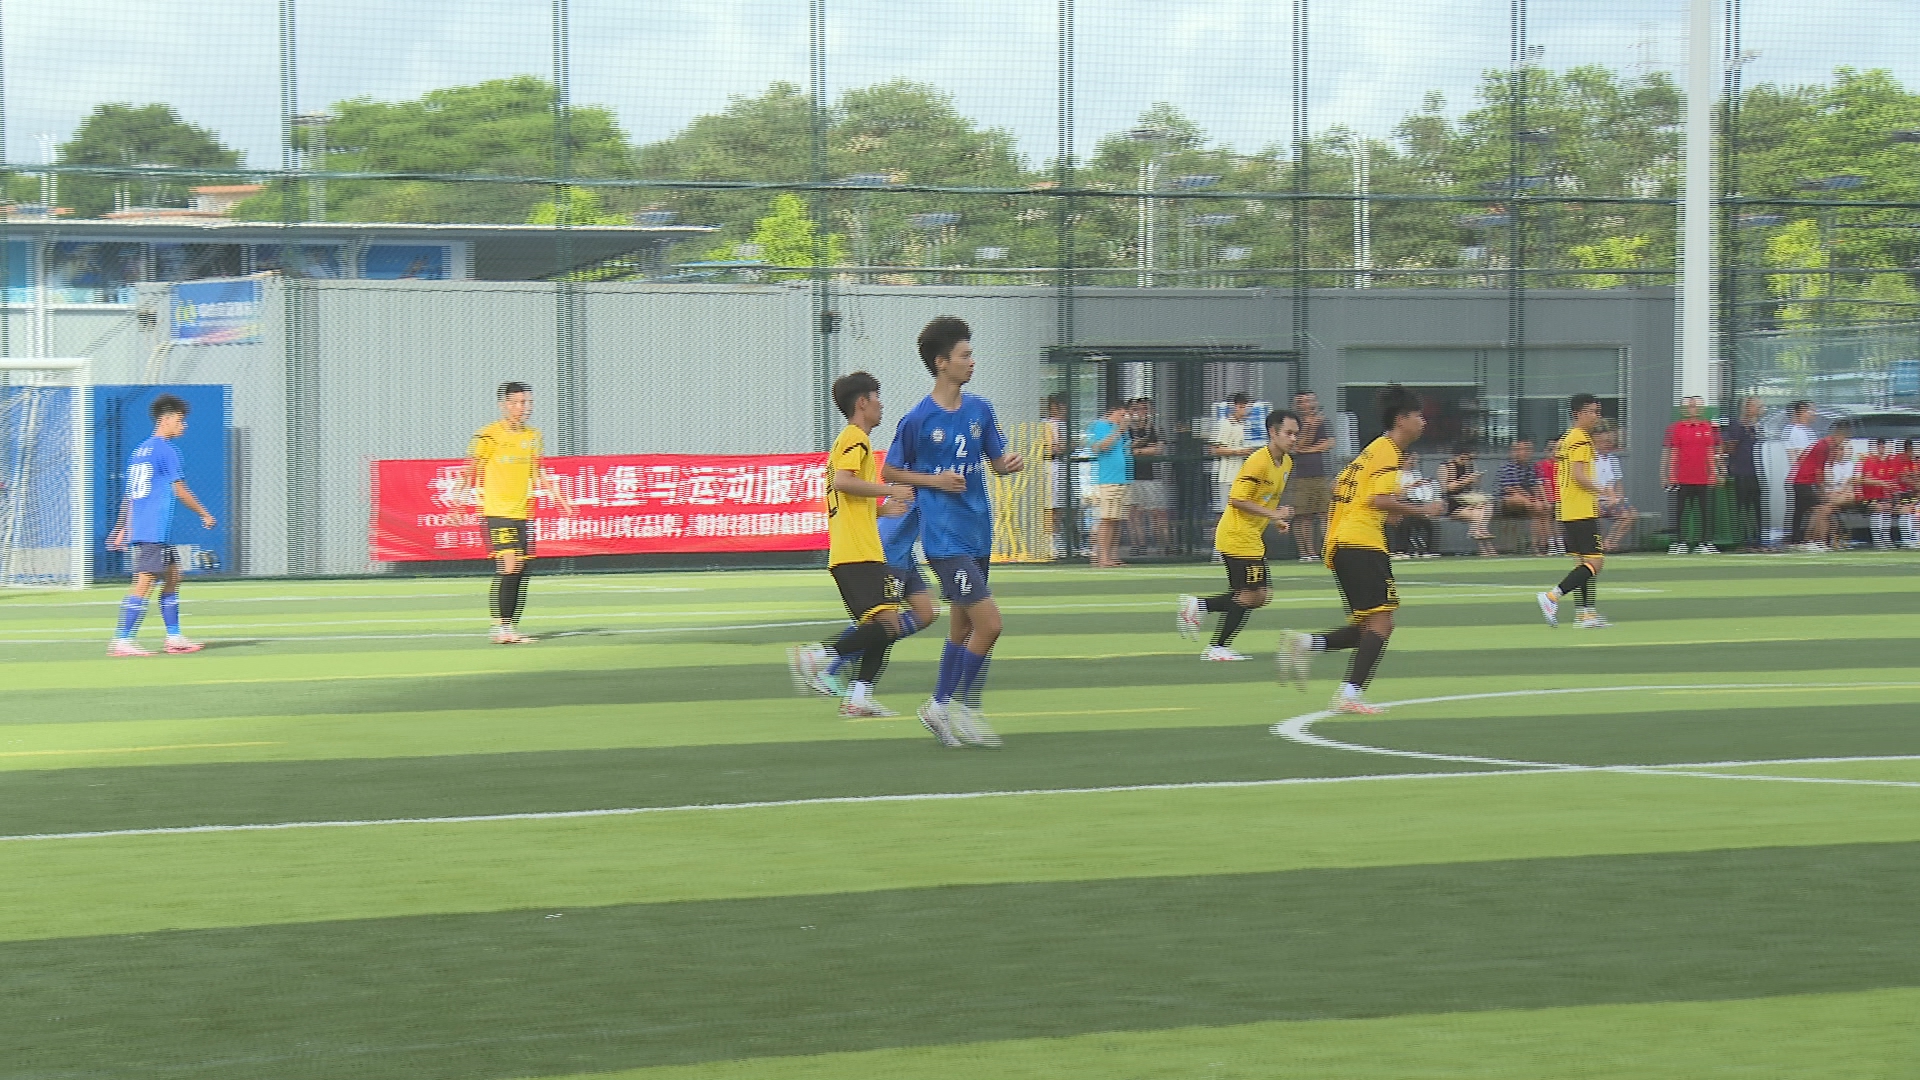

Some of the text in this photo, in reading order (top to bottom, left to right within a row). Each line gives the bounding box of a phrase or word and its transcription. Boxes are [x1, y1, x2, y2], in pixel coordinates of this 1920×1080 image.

[954, 433, 968, 459] 2
[127, 461, 154, 499] 28
[954, 569, 972, 595] 2
